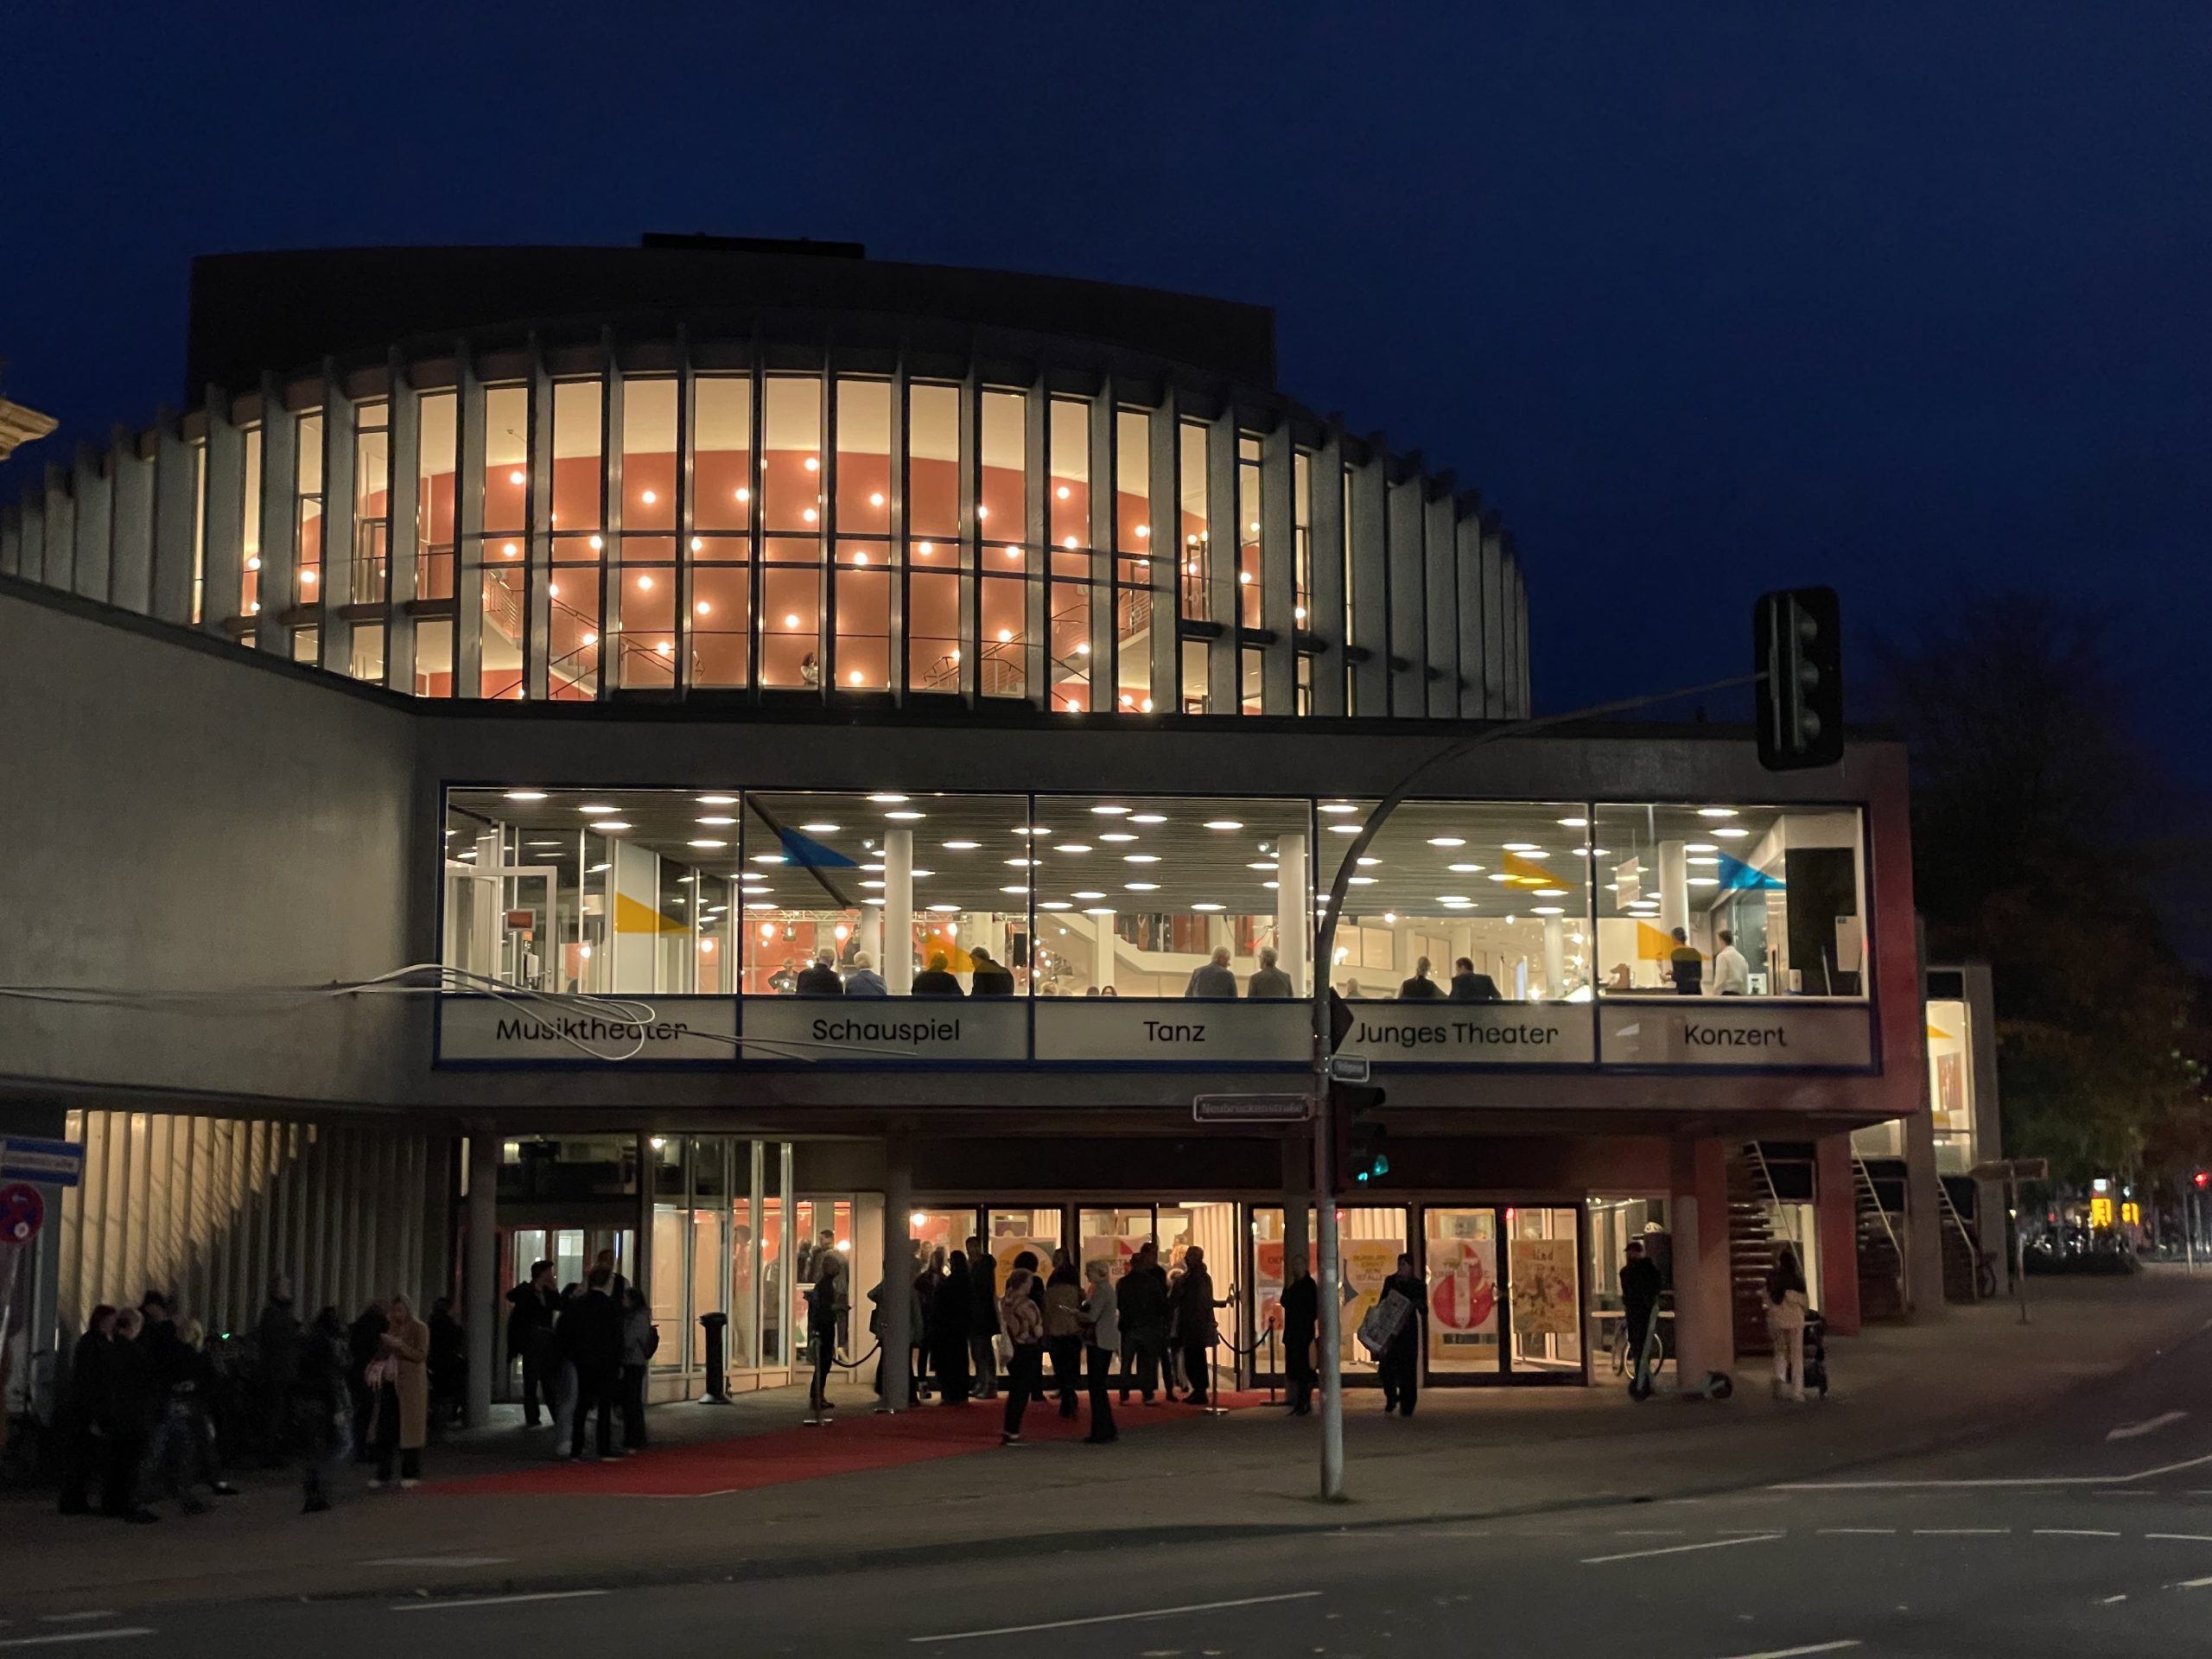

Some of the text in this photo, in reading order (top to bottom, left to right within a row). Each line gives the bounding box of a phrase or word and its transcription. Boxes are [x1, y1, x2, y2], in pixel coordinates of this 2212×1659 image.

[496, 1018, 688, 1040] Musiktheater
[812, 1018, 959, 1046] Schauspiel
[1143, 1020, 1205, 1041] Tanz
[1357, 1022, 1559, 1048] Junges Theater
[1684, 1024, 1788, 1046] Konzert
